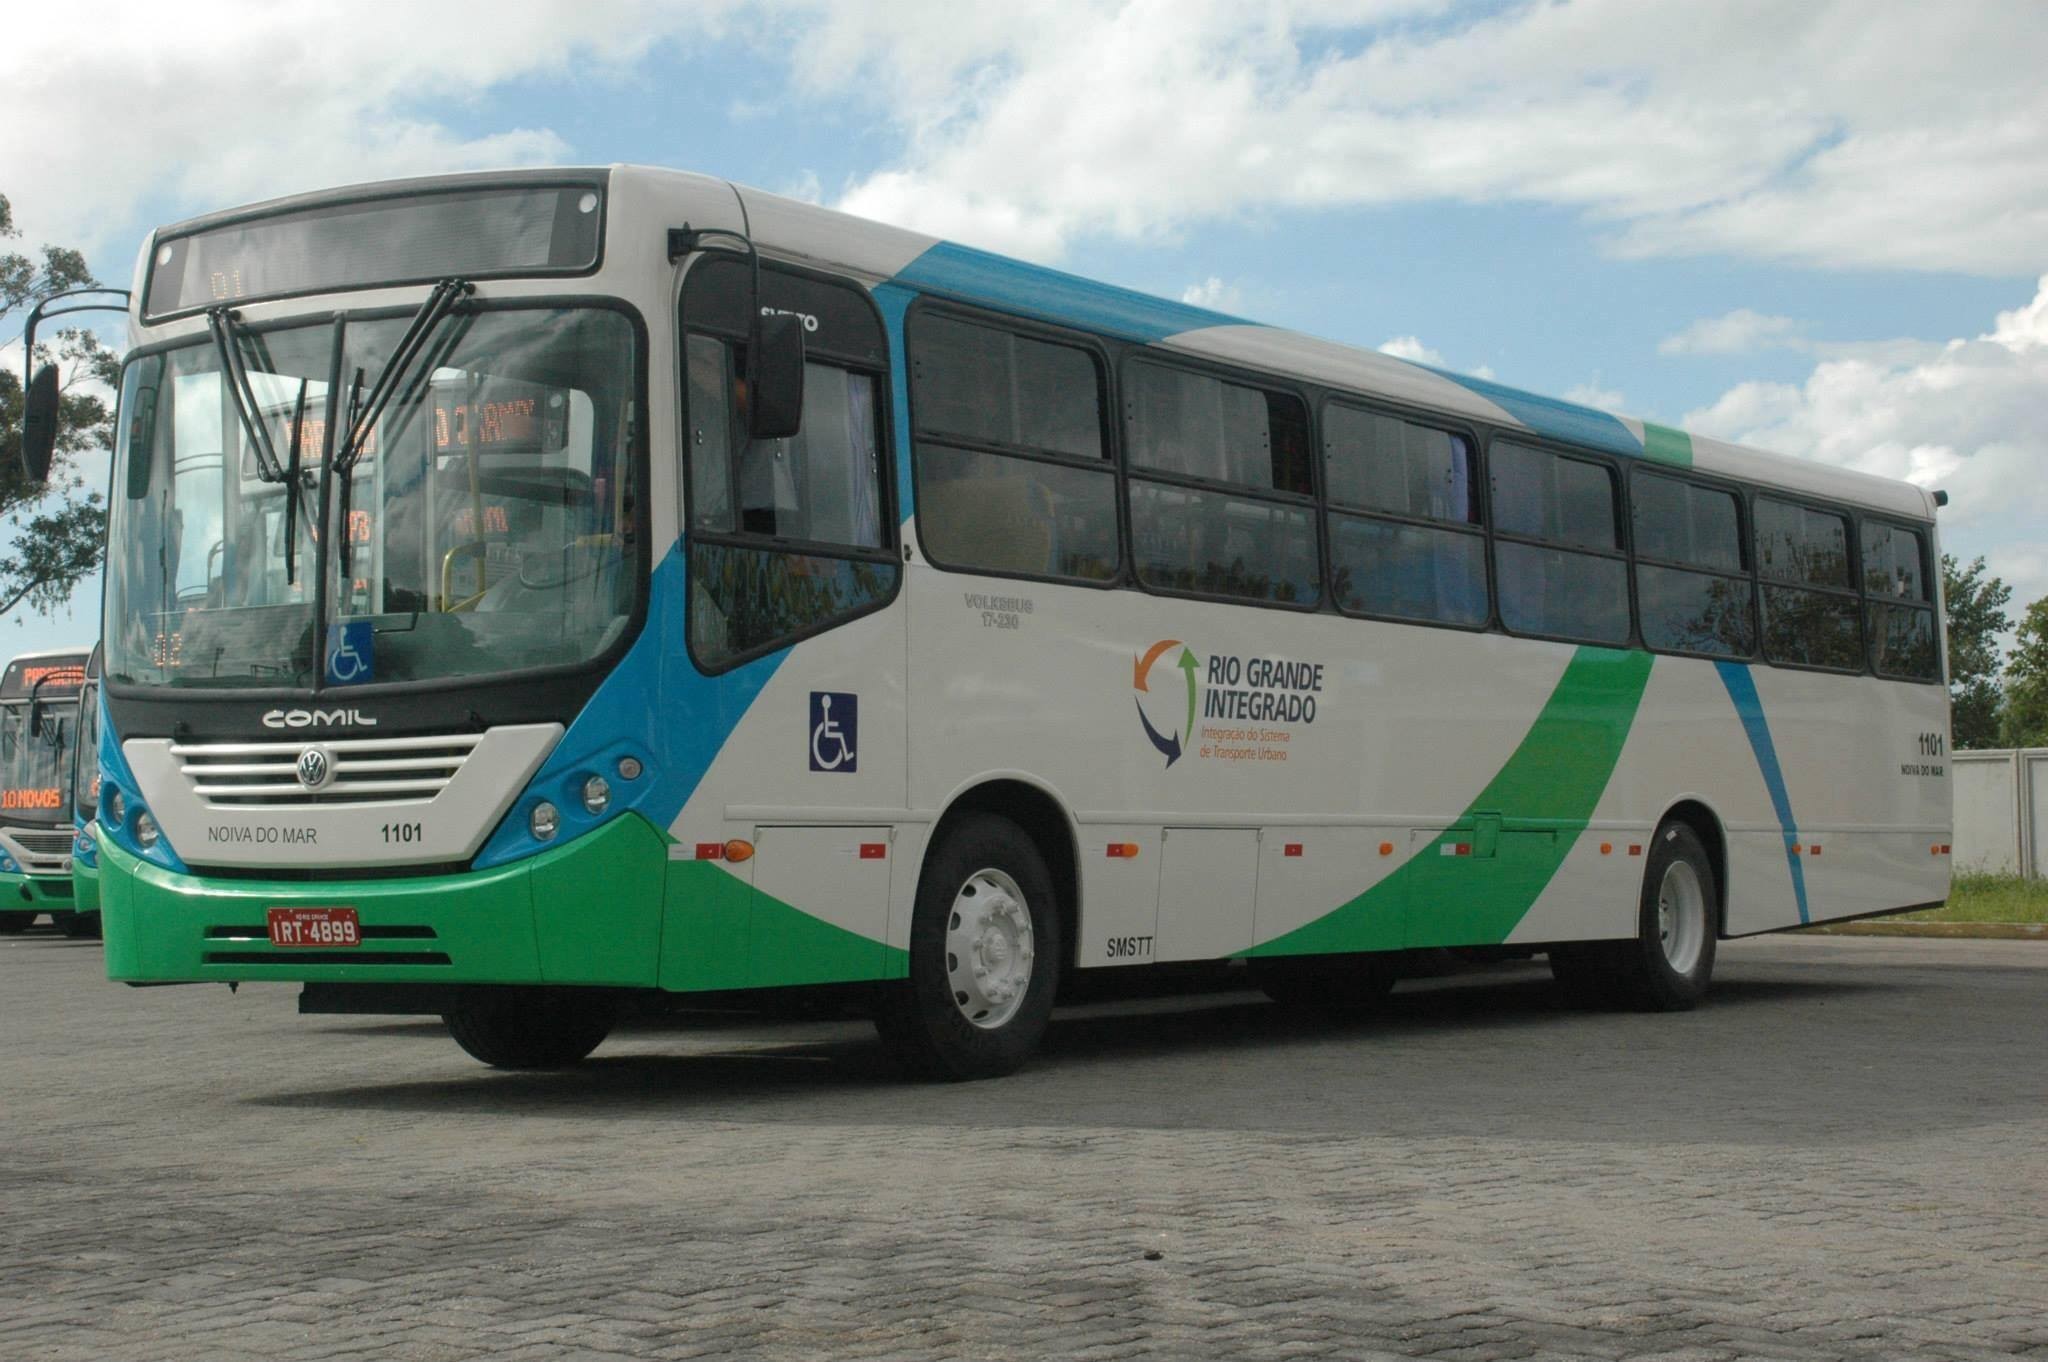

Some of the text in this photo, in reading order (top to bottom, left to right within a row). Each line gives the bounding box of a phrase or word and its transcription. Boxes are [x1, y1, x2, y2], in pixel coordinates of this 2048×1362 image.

[964, 592, 1033, 613] VOLKSBUS
[1207, 655, 1324, 692] RIO GRANDE
[1204, 688, 1317, 724] INTEGRADO
[262, 709, 377, 728] COMIL
[1201, 727, 1290, 743] Integração do Sistema
[1918, 732, 1943, 757] 1101
[1200, 744, 1287, 762] de Transporte Urbano
[18, 789, 61, 808] NOVOS
[208, 826, 317, 843] NOIVA DO MAR
[382, 823, 422, 842] 1101
[1106, 936, 1153, 957] SMSTT
